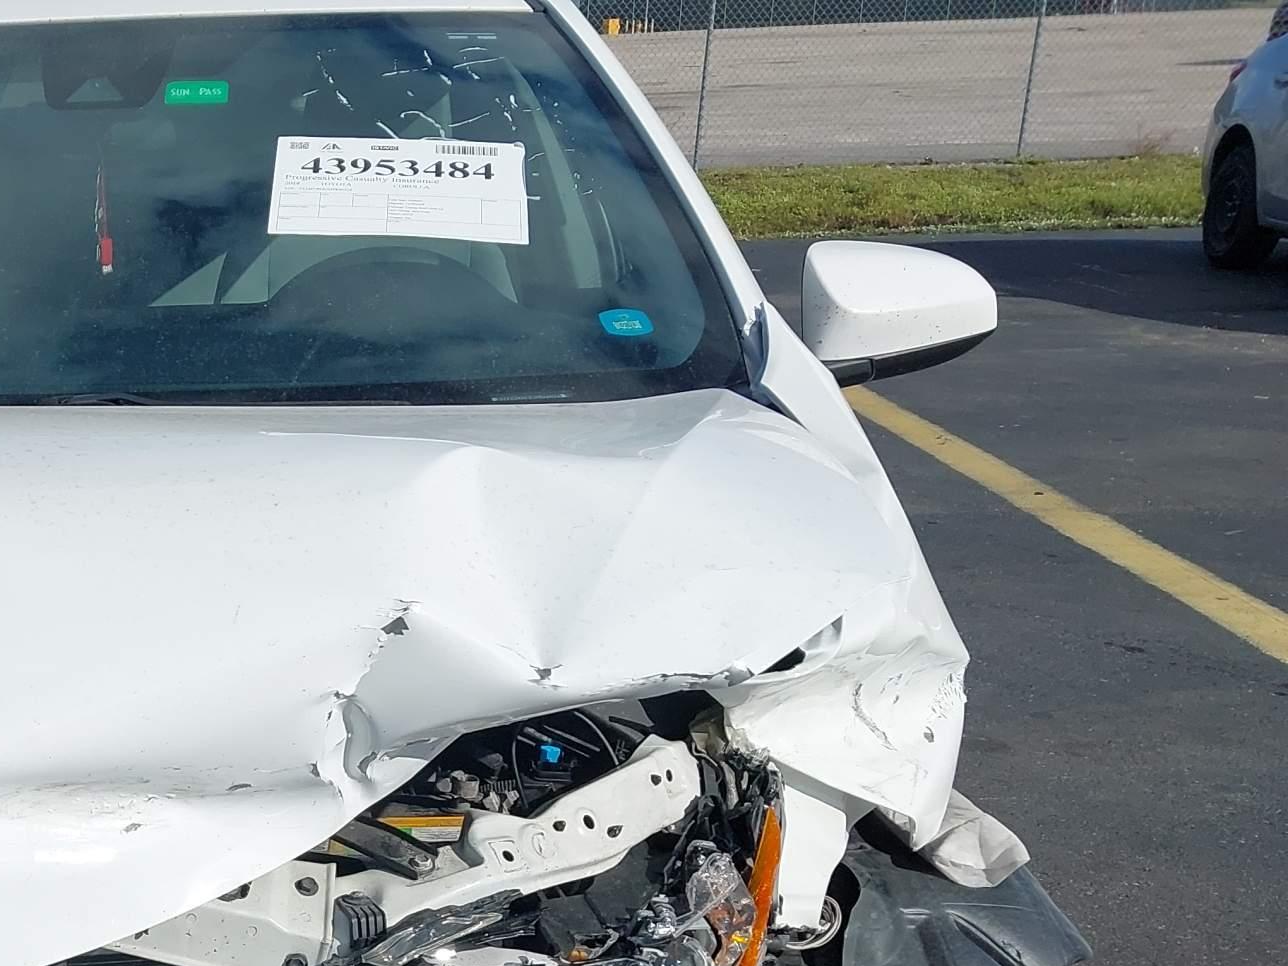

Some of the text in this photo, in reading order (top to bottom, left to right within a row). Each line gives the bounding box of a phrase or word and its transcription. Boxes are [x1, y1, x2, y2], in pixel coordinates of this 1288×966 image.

[170, 87, 222, 96] SUN PASS
[300, 157, 495, 180] 43953484
[285, 174, 343, 182] Progressive
